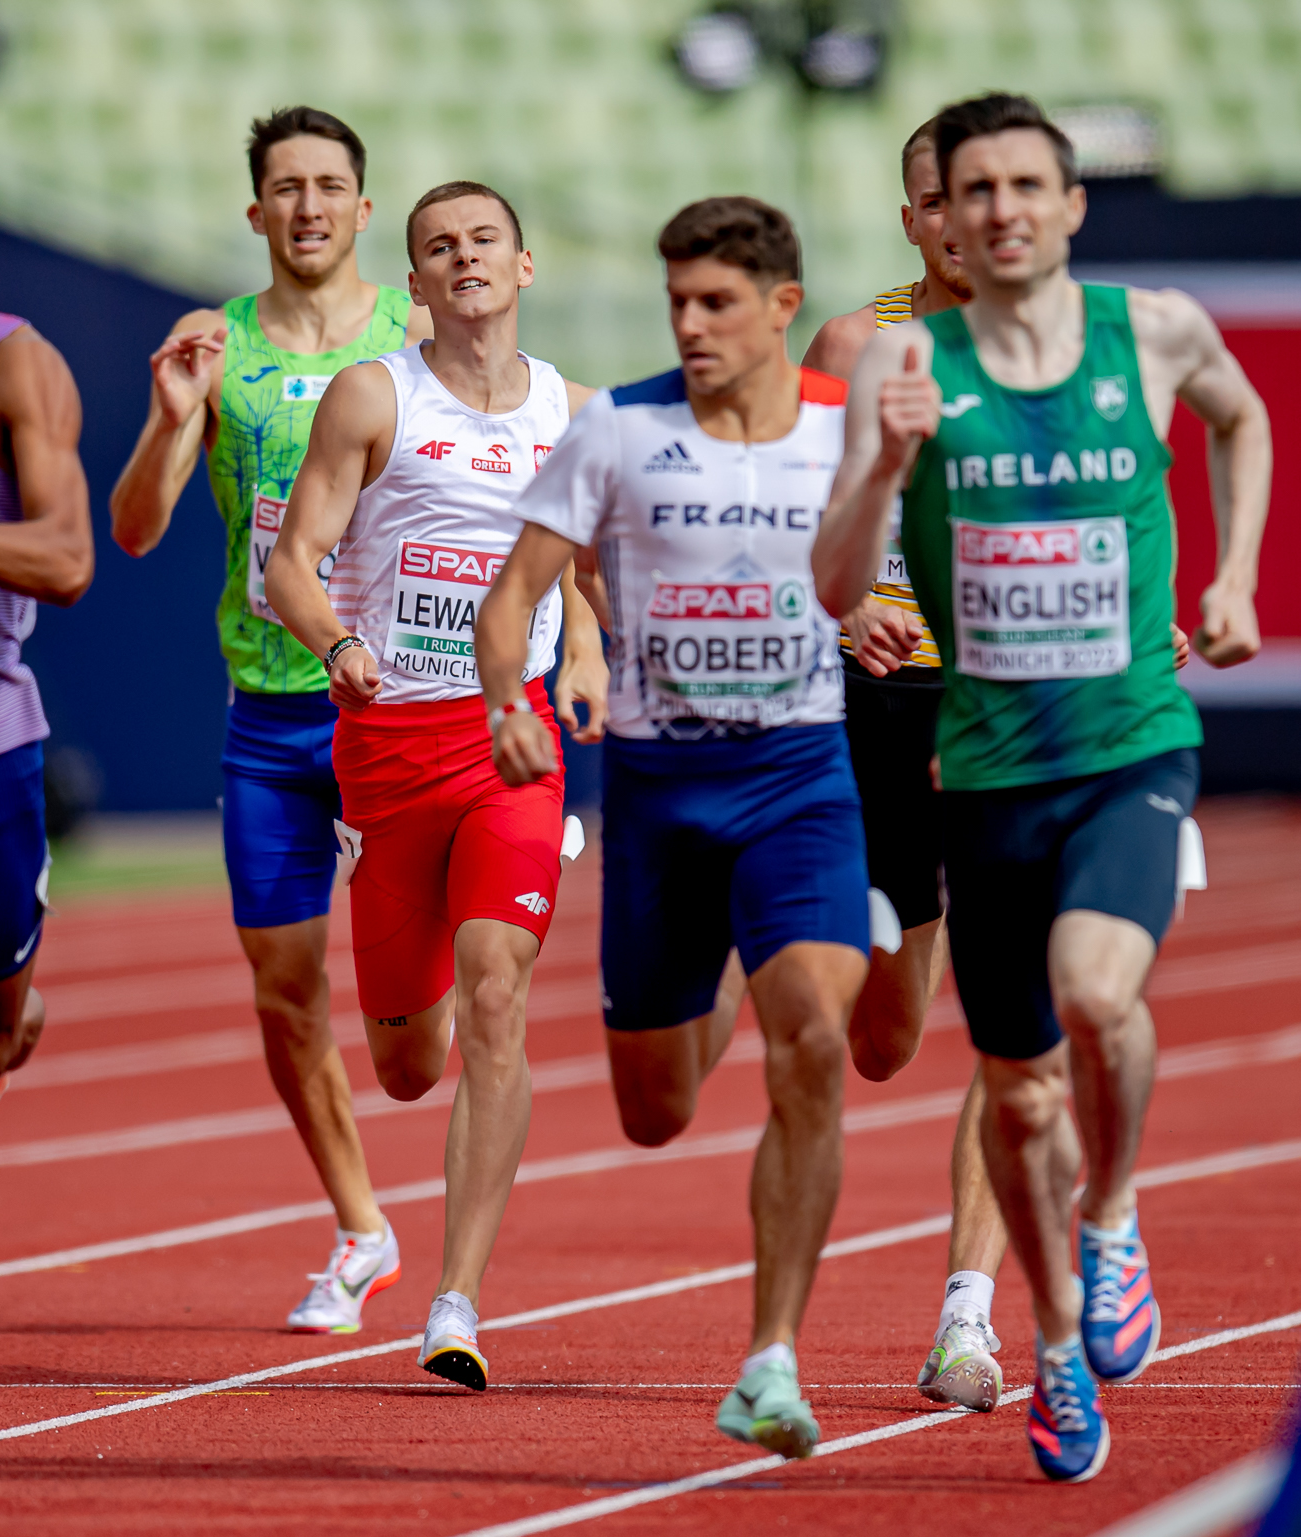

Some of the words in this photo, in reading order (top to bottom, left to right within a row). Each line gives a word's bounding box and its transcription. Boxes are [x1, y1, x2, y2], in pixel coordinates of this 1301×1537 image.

[416, 440, 456, 460] 4F
[473, 460, 509, 472] ORLEN
[945, 447, 1137, 490] IRELAND
[651, 503, 824, 530] FRANC
[961, 527, 1078, 562] SPAR
[652, 587, 769, 616] SPAR
[960, 580, 1118, 621] ENGLISH
[397, 591, 538, 640] LEWAI
[431, 640, 460, 653] RUN
[648, 634, 807, 672] ROBERT
[394, 652, 476, 680] MUNICH
[515, 891, 550, 916] 4F
